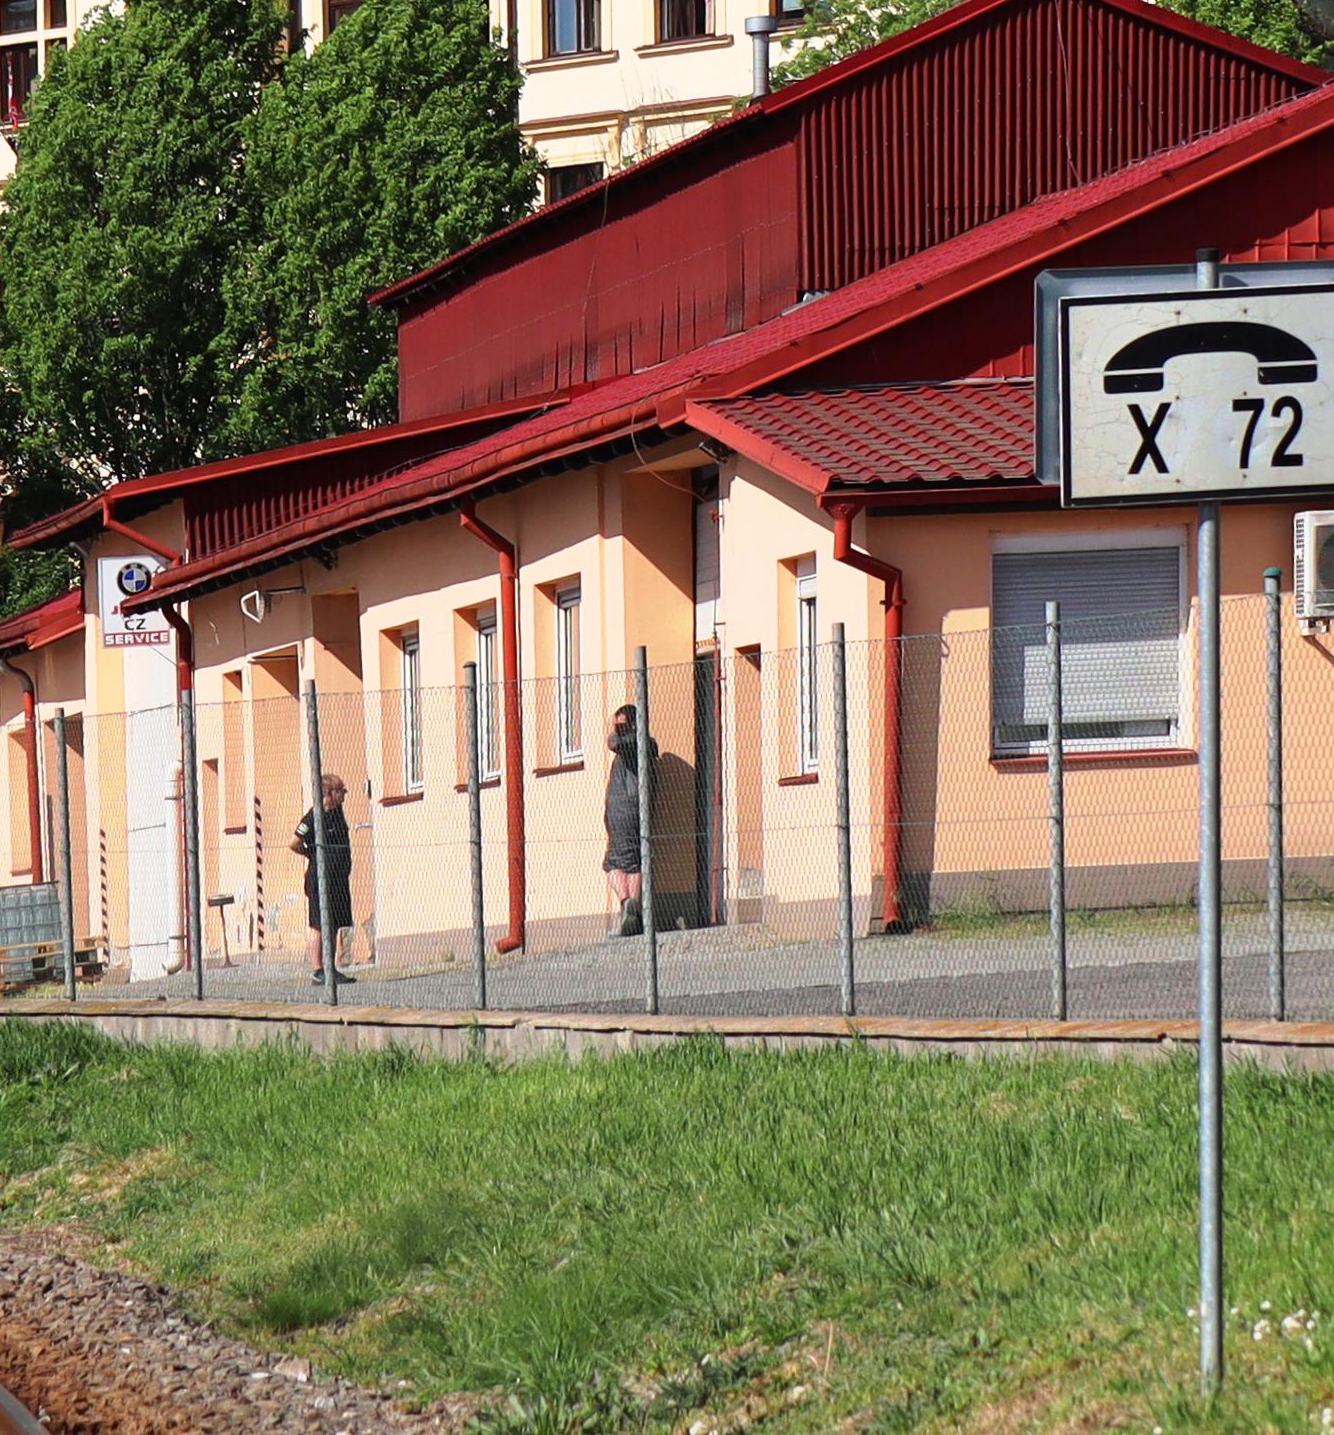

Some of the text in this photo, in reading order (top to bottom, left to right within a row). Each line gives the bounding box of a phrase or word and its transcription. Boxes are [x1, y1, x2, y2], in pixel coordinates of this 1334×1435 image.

[1127, 396, 1303, 474] X 72
[124, 619, 146, 631] CZ
[105, 632, 169, 645] SERVICE
